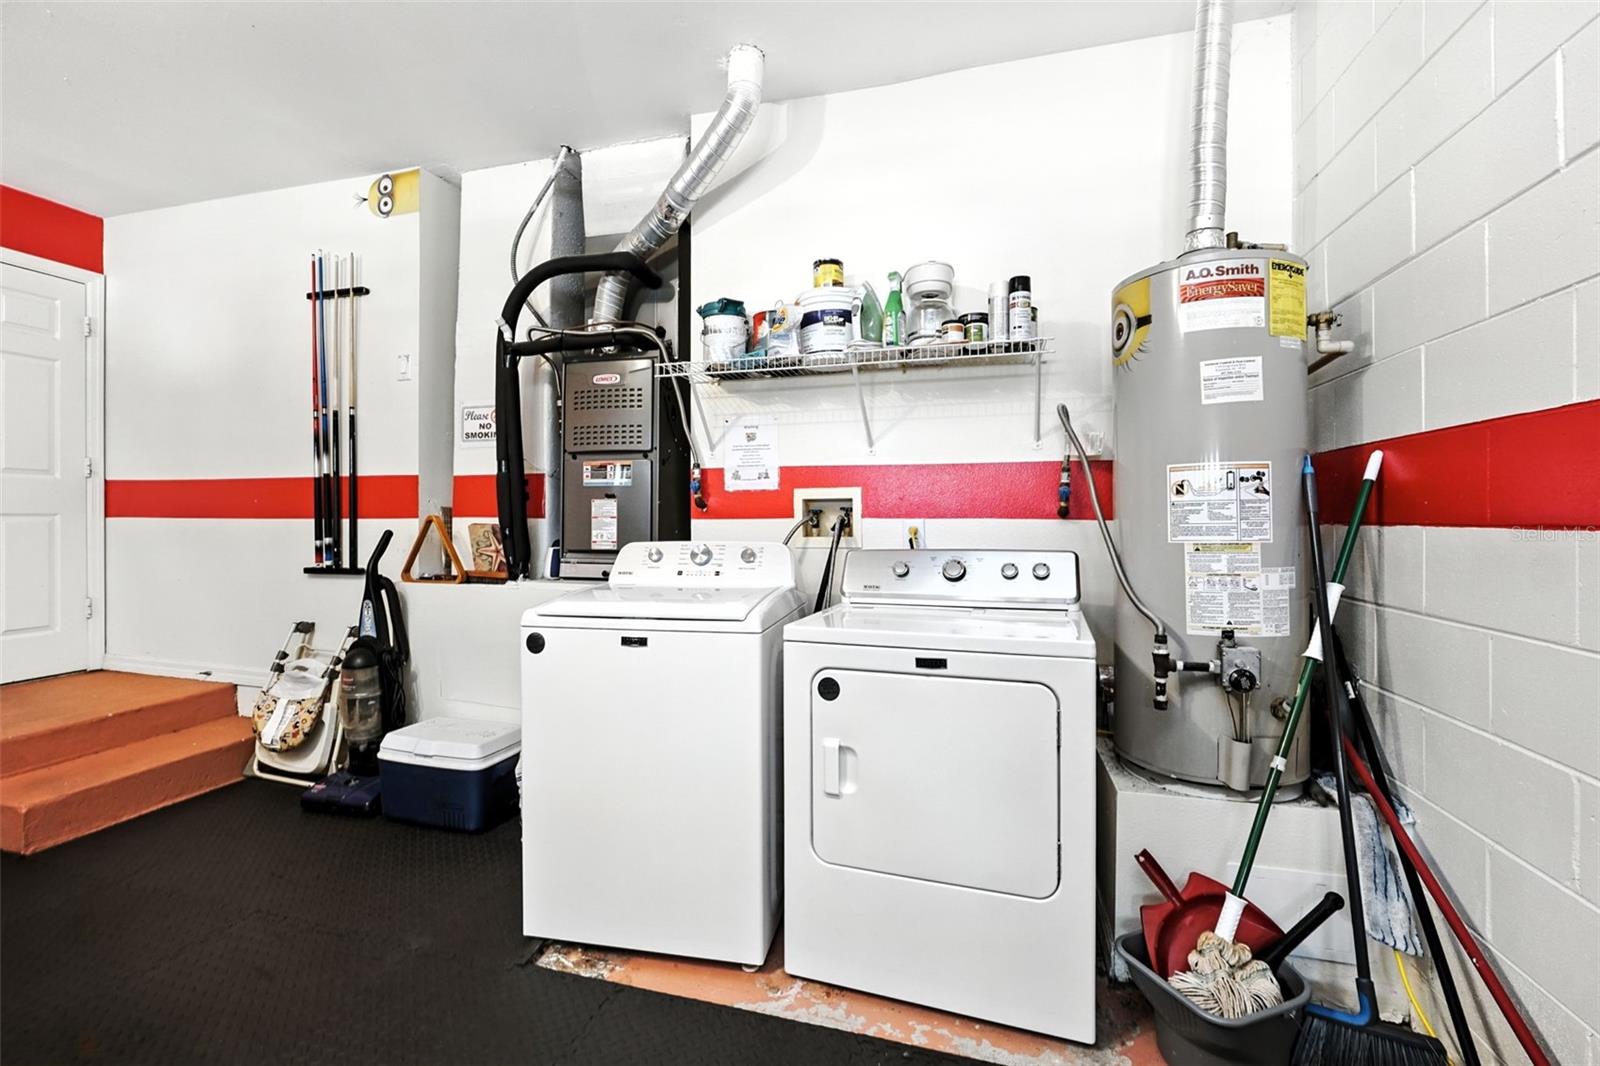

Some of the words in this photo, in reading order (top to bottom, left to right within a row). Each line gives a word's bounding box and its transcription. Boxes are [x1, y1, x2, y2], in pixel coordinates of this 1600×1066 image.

[1186, 267, 1214, 281] A.O.
[1215, 264, 1259, 276] Smith
[1186, 281, 1258, 297] EnergySaver
[465, 411, 489, 421] Please
